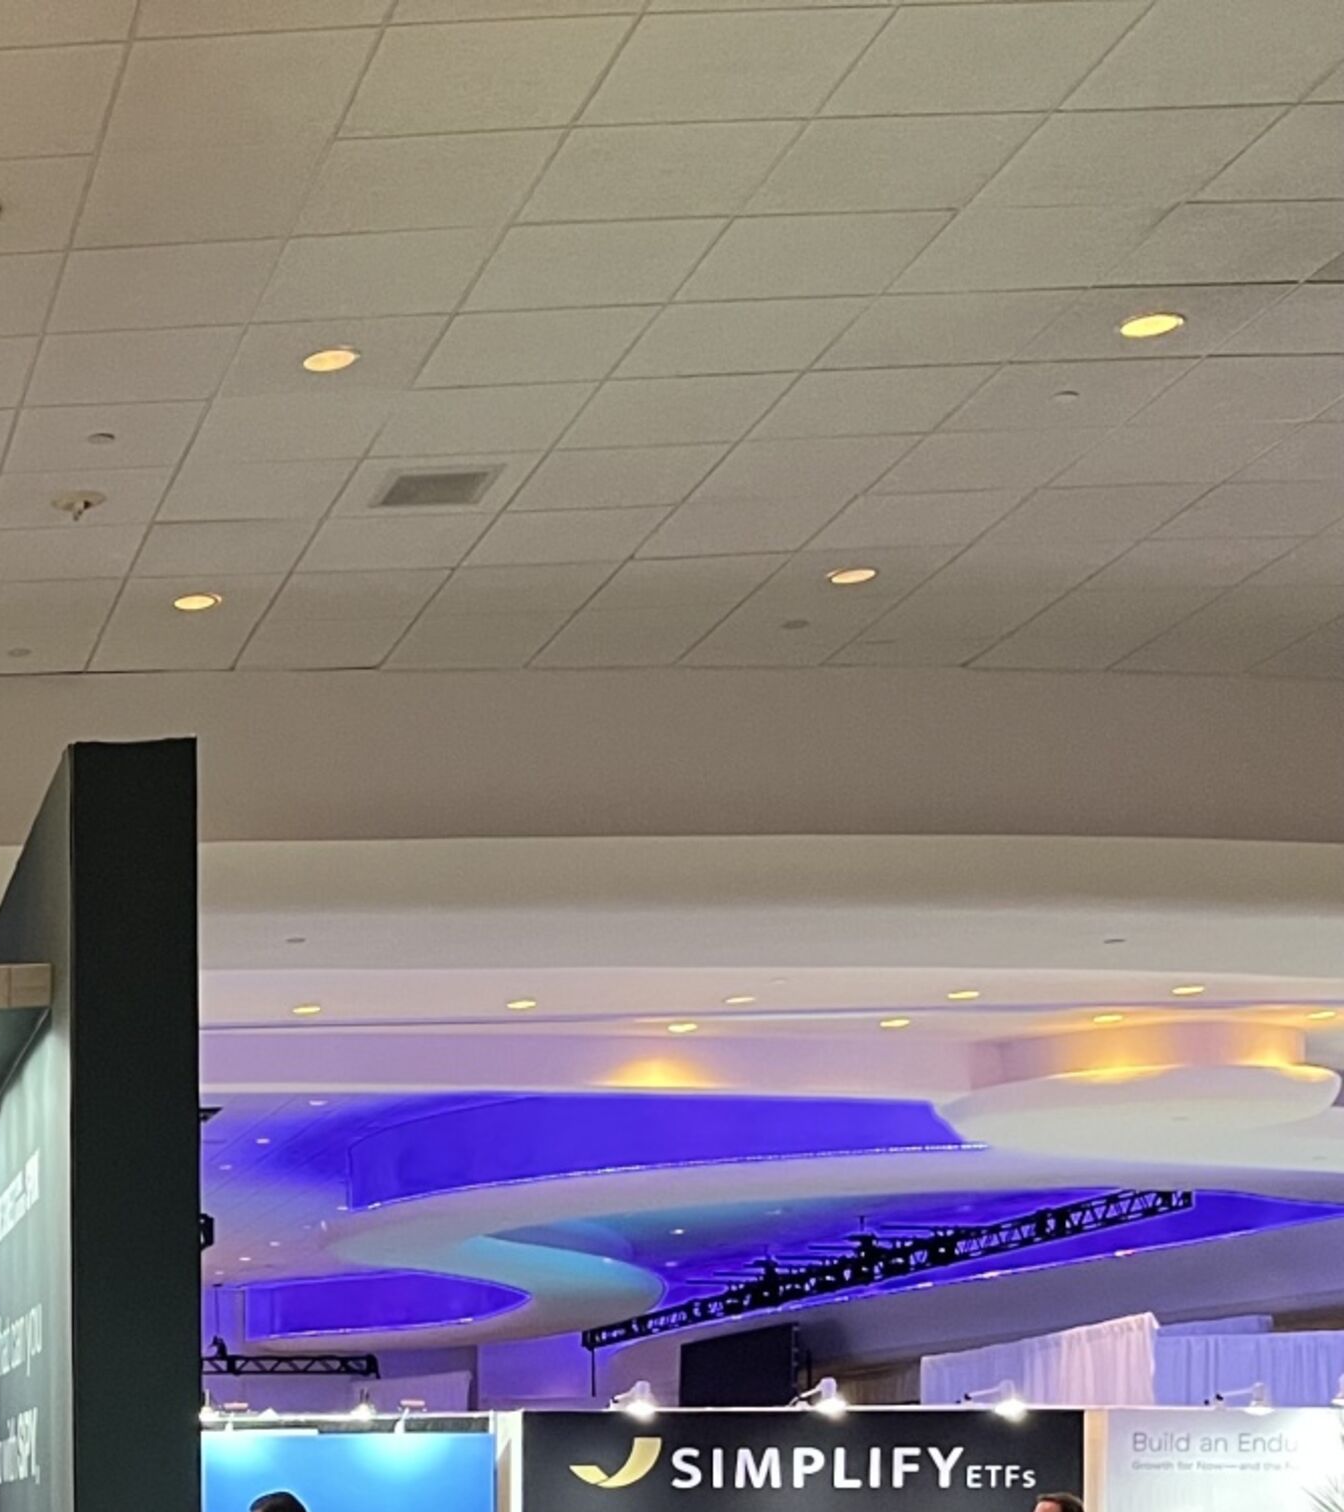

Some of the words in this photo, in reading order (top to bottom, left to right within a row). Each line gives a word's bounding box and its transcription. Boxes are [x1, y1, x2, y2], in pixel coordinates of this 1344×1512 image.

[1132, 1432, 1191, 1453] Build
[1200, 1436, 1229, 1453] an
[671, 1447, 964, 1489] SIMPLIFY
[965, 1464, 1037, 1489] ETFs
